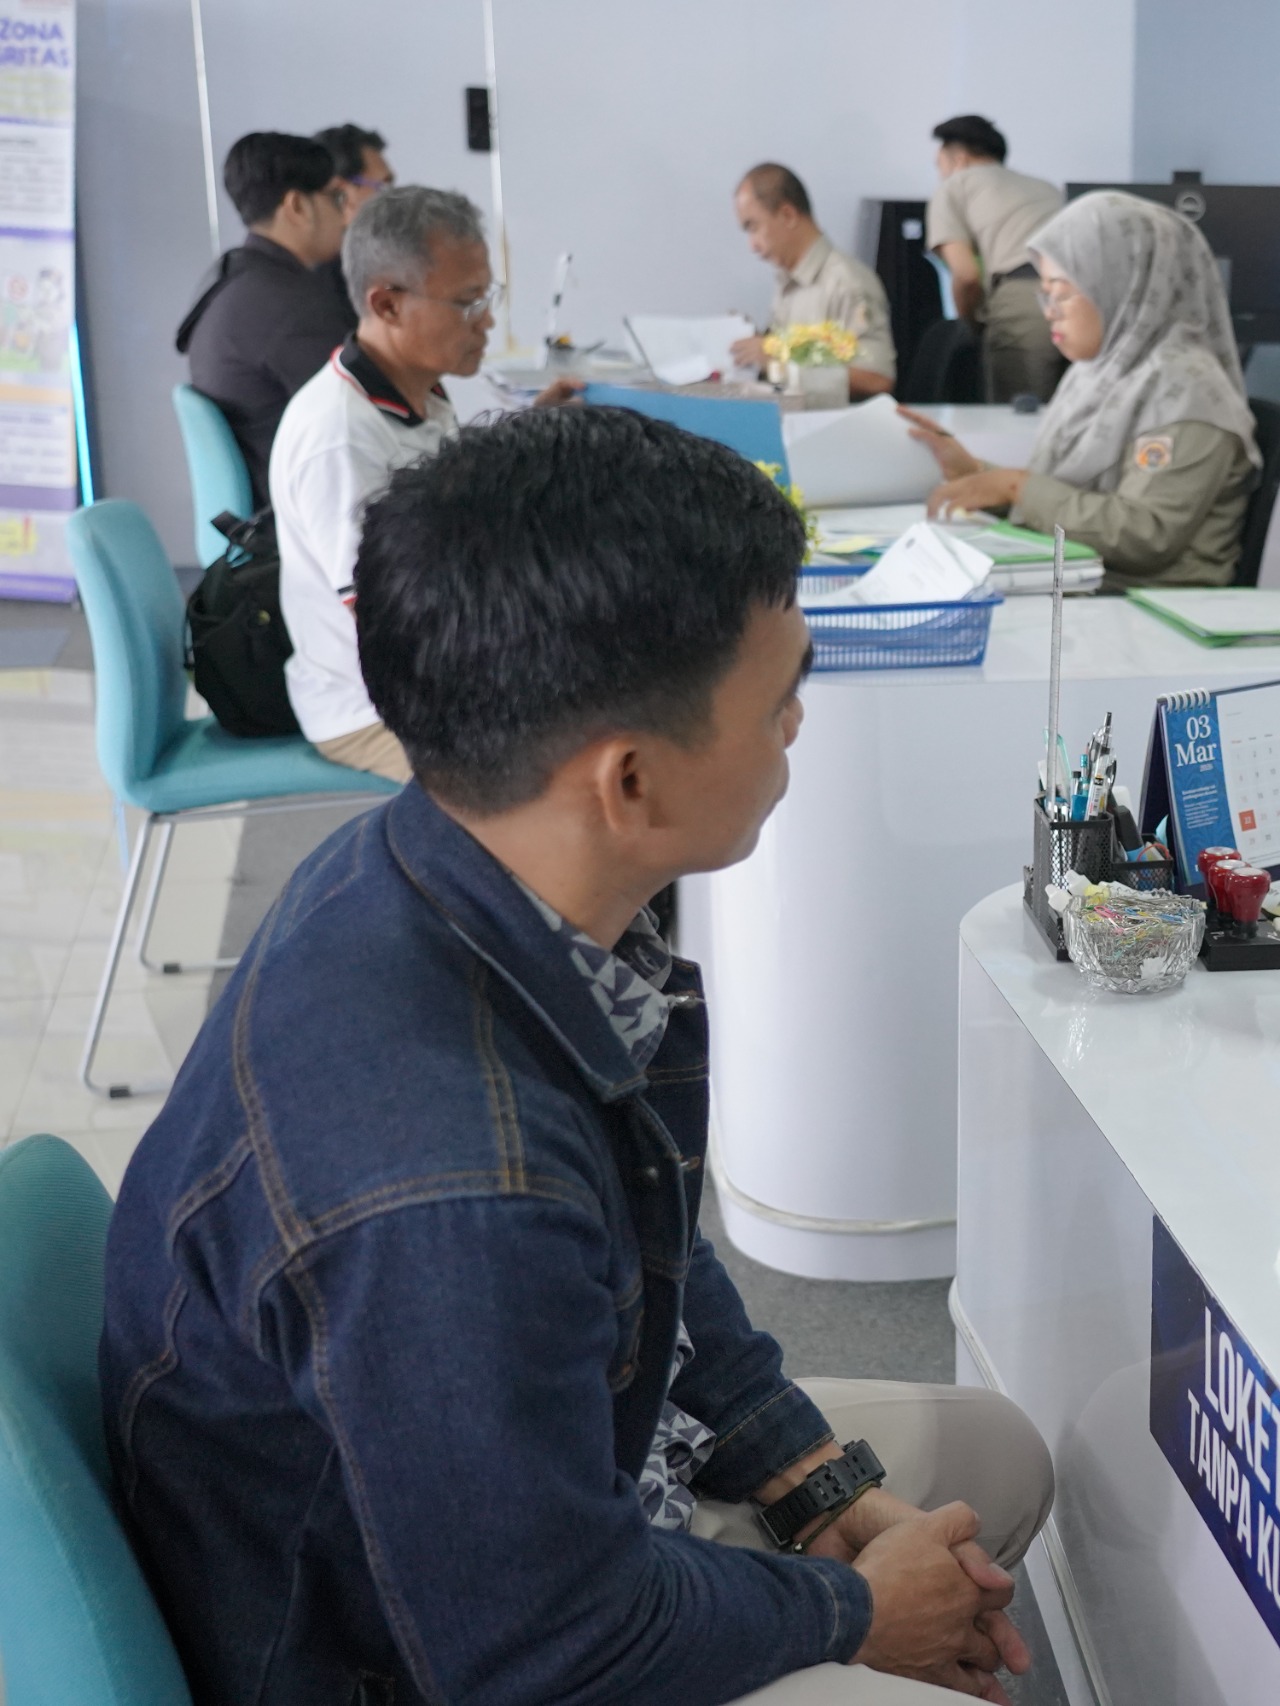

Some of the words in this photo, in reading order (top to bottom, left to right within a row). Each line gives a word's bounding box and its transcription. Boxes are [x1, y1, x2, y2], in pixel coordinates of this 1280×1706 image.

[1186, 714, 1212, 741] 03
[1174, 741, 1217, 767] Mar
[1187, 1387, 1252, 1560] TANPA
